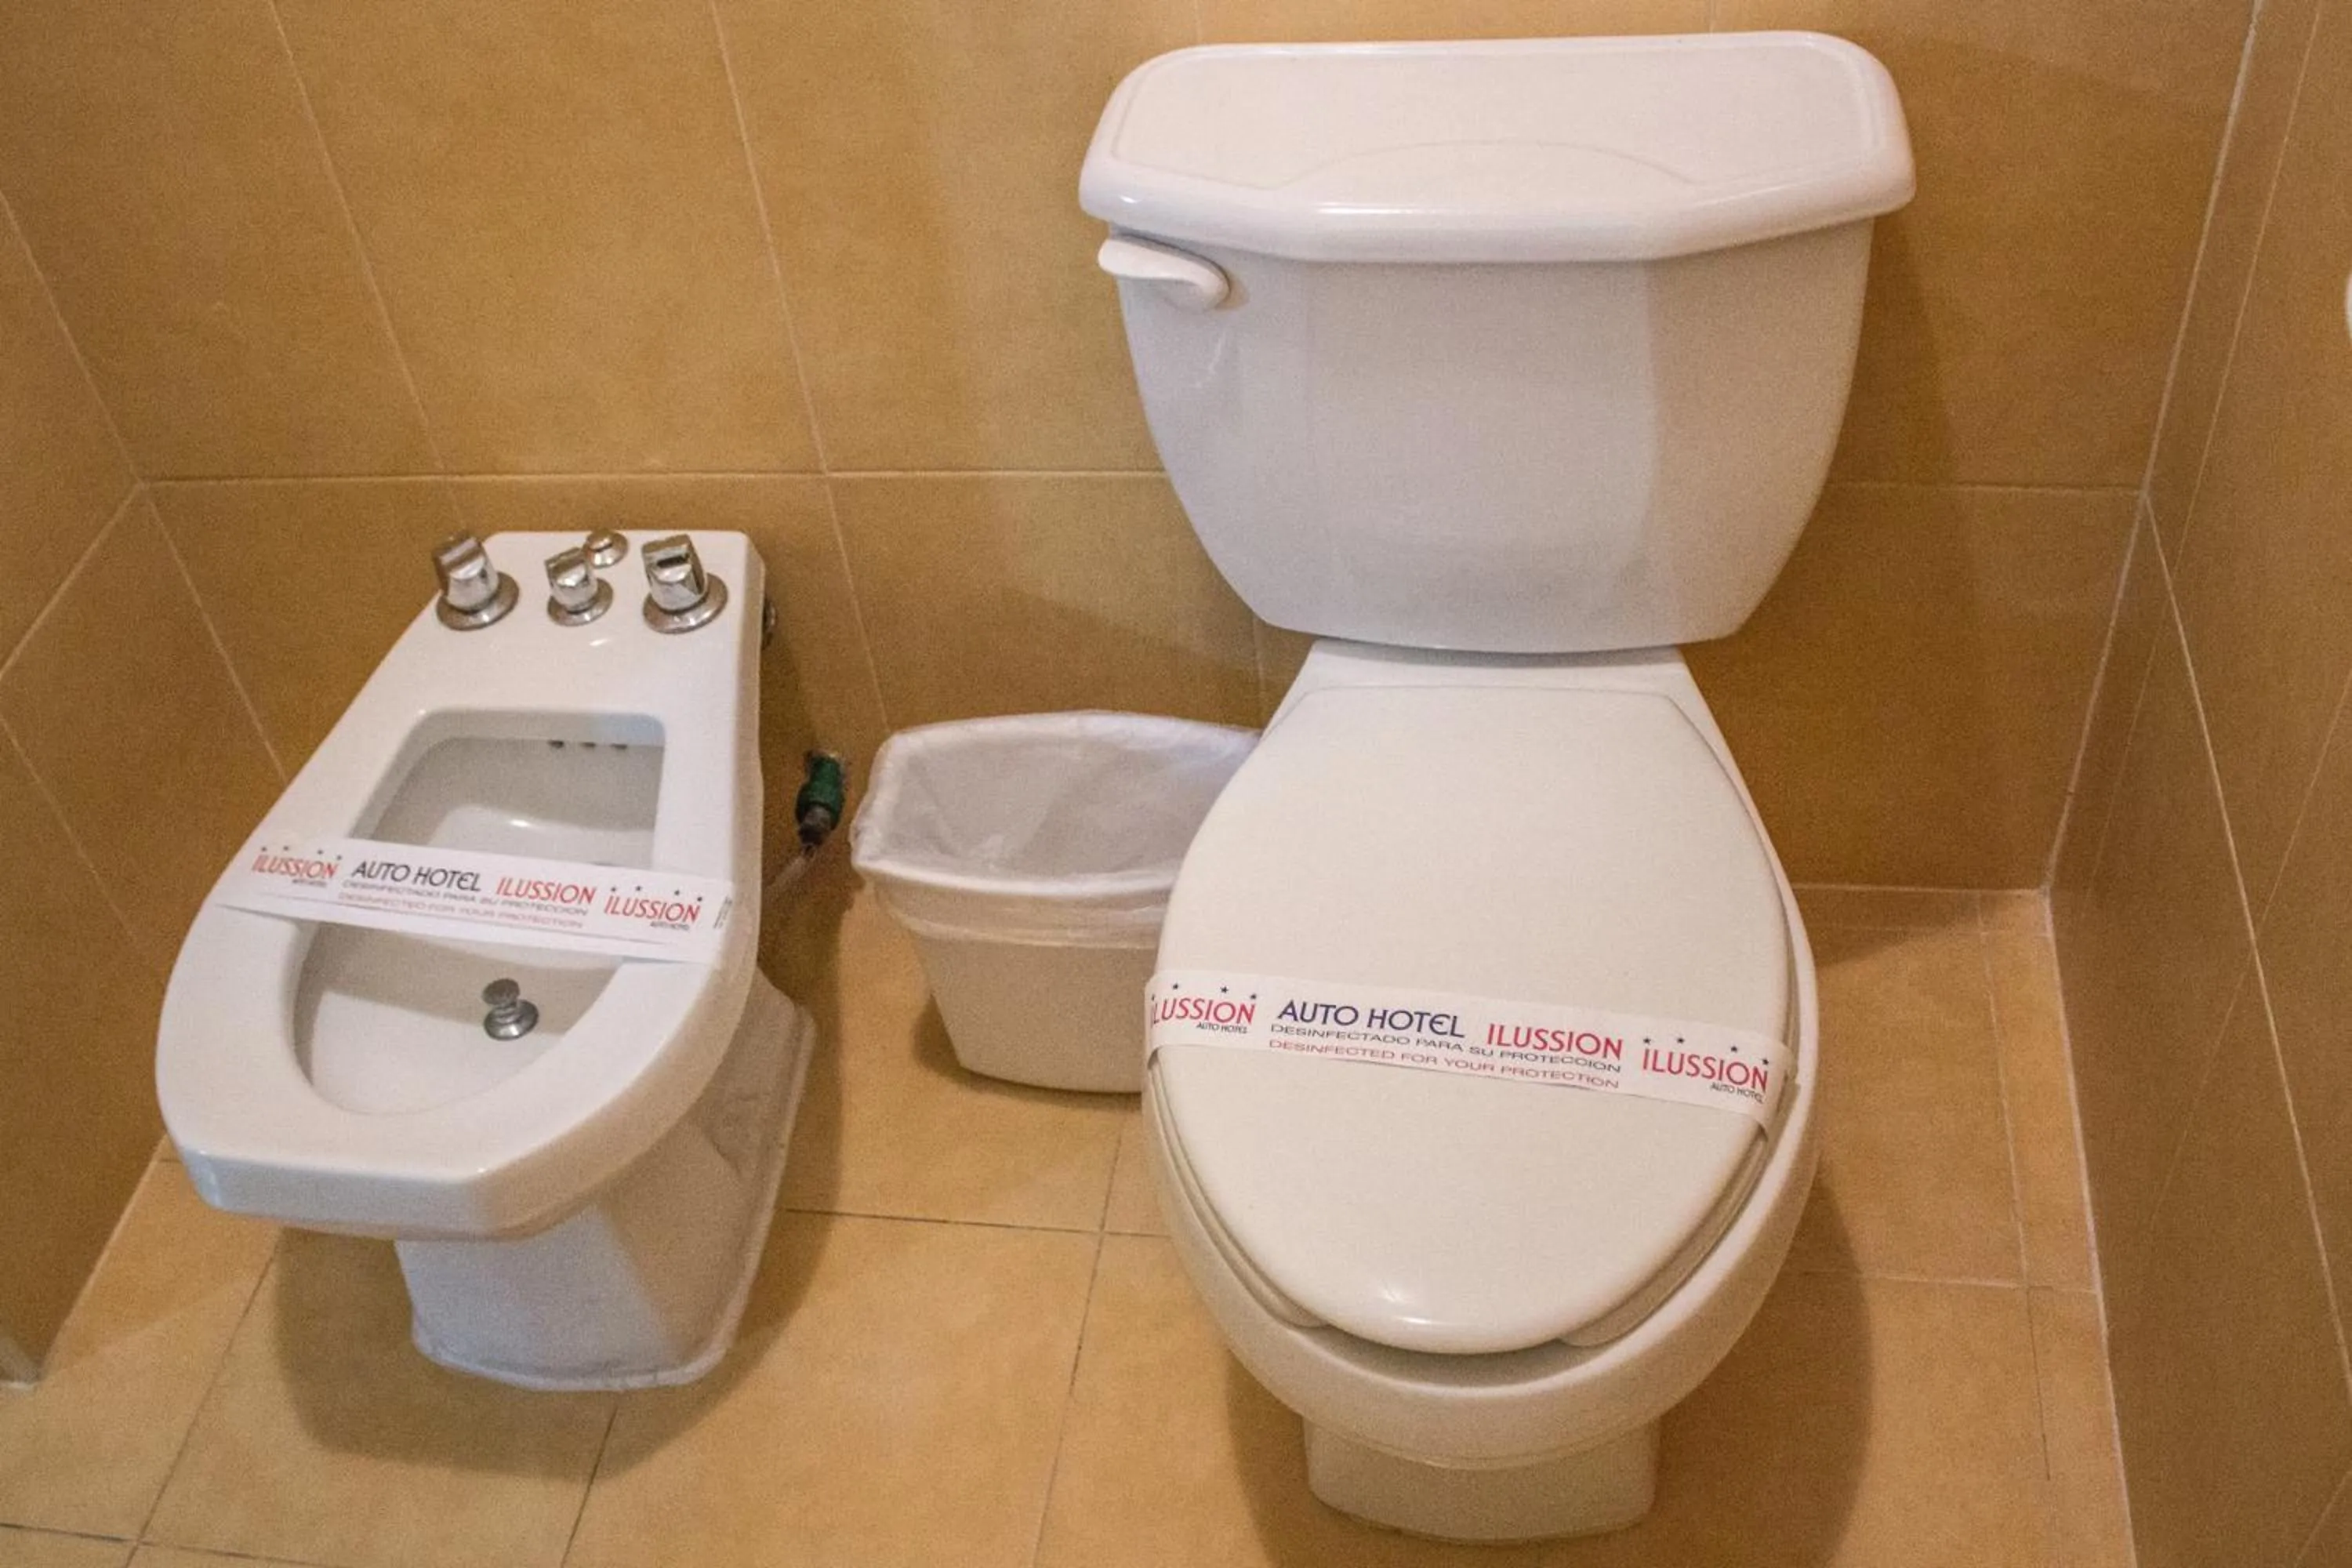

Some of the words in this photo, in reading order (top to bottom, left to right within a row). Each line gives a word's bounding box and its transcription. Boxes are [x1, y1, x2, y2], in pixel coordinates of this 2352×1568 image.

[252, 854, 339, 879] ILUSSION
[352, 861, 411, 882] AUTO
[412, 866, 481, 891] HOTEL
[496, 877, 597, 905] ILUSSION
[604, 895, 700, 923] ILUSSION
[1196, 1022, 1220, 1031] AUTO
[1277, 1000, 1359, 1026] AUTO
[1367, 1008, 1465, 1038] HOTEL
[1270, 1023, 1410, 1045] DESINFECTADO
[1416, 1038, 1465, 1054] PARA
[1469, 1046, 1494, 1057] SU
[1500, 1051, 1622, 1074] PROTECCION
[1486, 1023, 1624, 1061] ILUSSION
[1269, 1039, 1395, 1059] DESINFECTED
[1400, 1052, 1438, 1065] FOR
[1443, 1058, 1495, 1073] YOUR
[1501, 1066, 1620, 1089] PROTECTION
[1642, 1048, 1768, 1093] ILUSSION
[1710, 1082, 1735, 1094] AUTO
